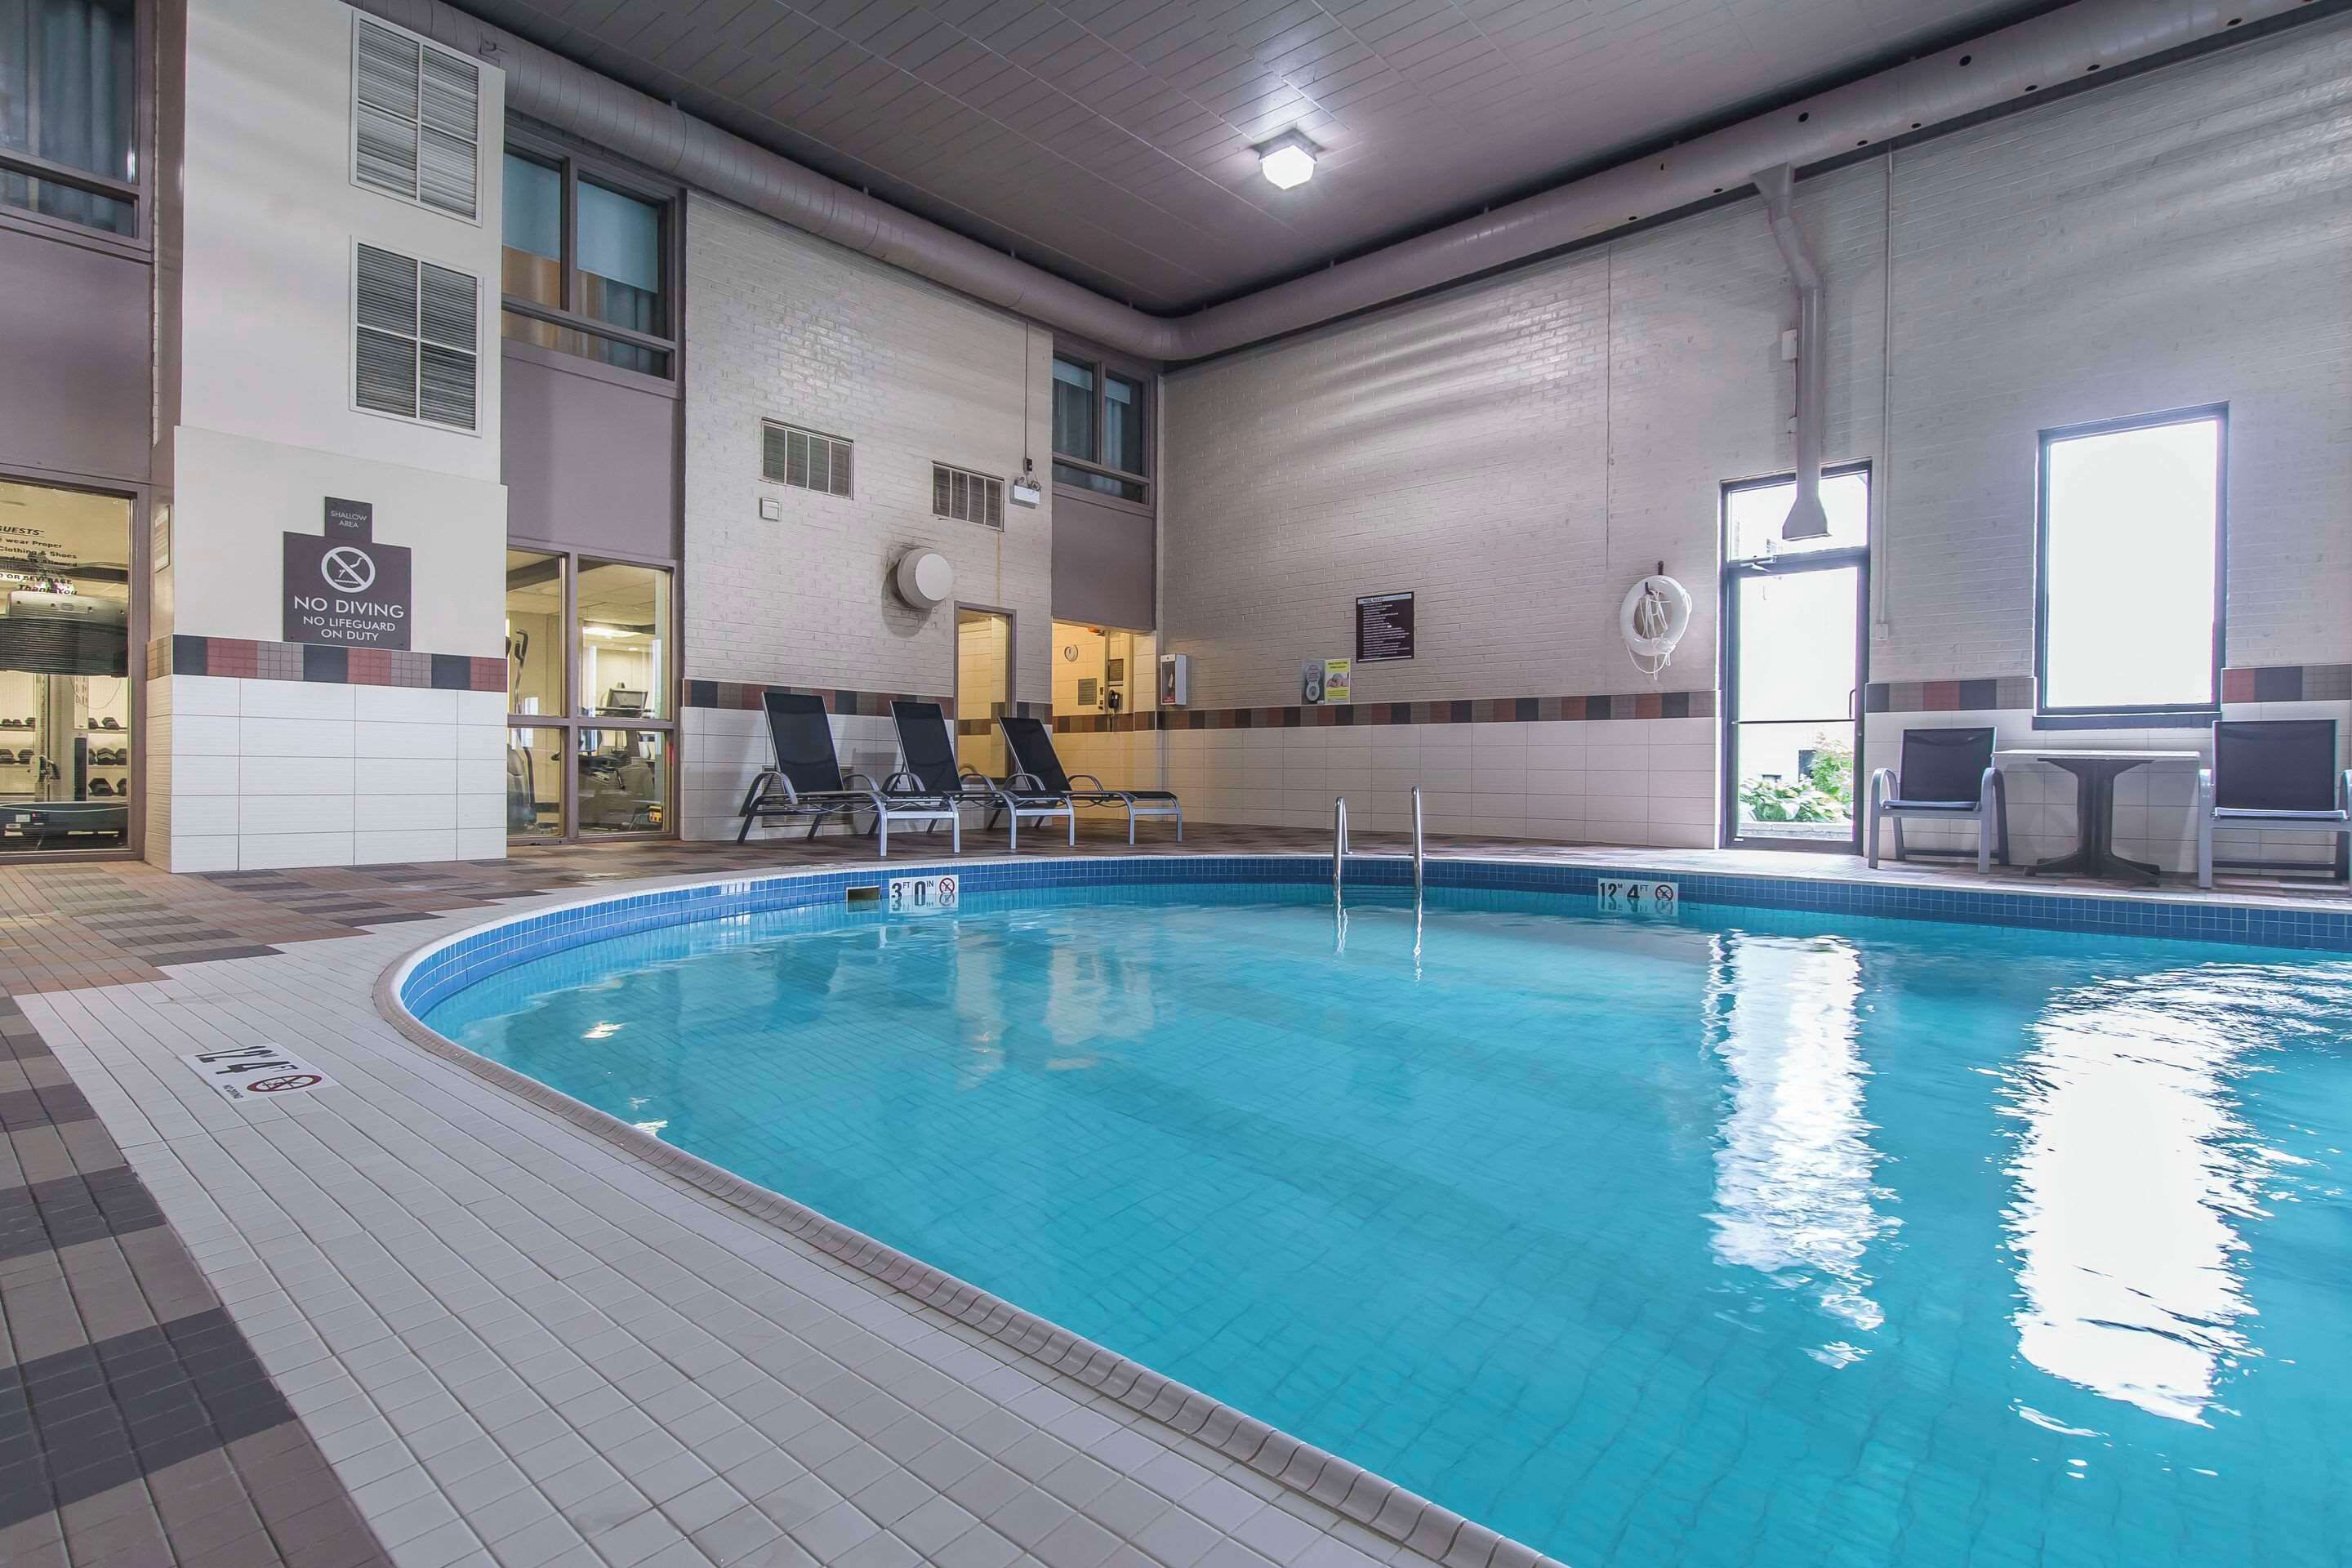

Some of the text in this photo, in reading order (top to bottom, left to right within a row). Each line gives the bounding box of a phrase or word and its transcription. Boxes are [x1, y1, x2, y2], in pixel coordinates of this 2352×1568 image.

[330, 510, 368, 521] SHALLOW
[339, 519, 359, 528] AREA
[32, 540, 63, 548] Proper
[50, 551, 78, 559] Shoes
[294, 595, 405, 618] NO DIVING
[303, 616, 396, 631] NO LIFEGUARD
[321, 628, 379, 641] ON DUTY
